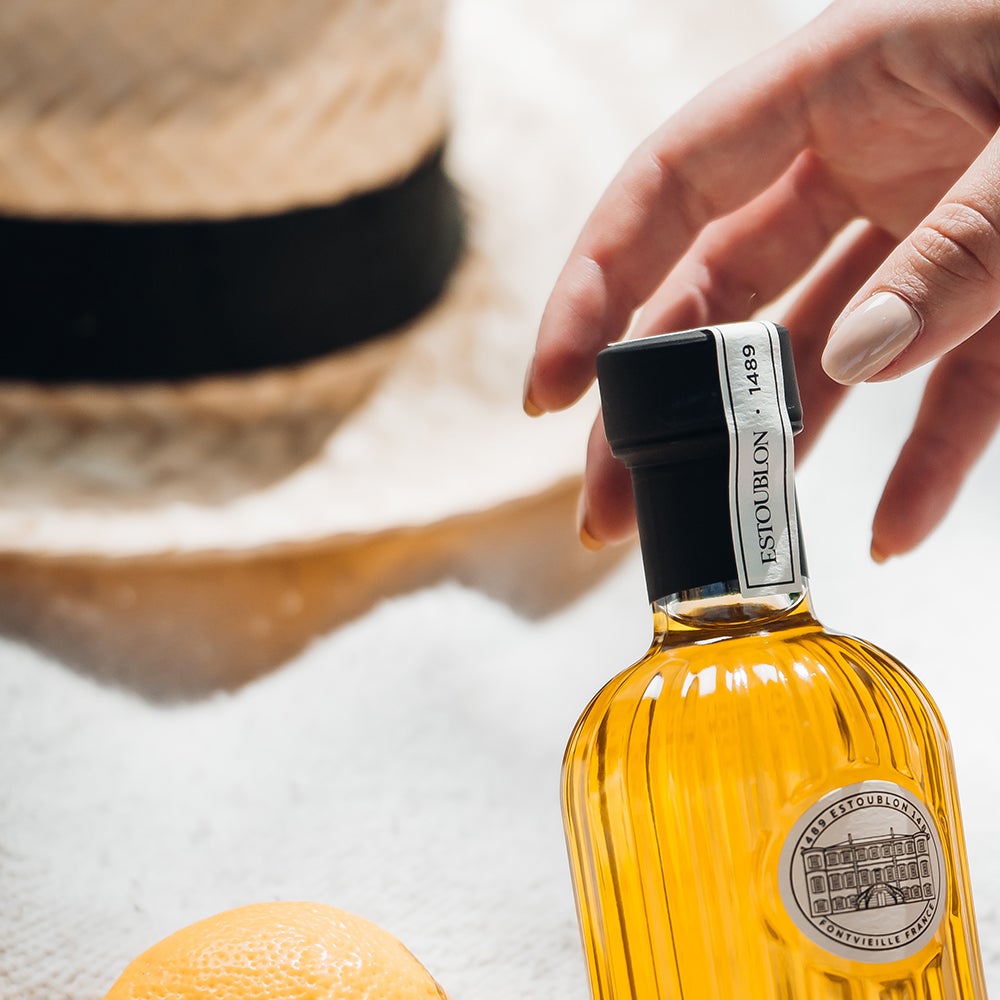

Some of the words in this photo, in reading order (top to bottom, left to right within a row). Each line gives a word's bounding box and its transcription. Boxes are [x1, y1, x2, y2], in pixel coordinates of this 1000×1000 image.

[743, 345, 762, 395] 1489
[753, 431, 777, 564] ESTOUBLON
[800, 818, 827, 850] 489
[830, 795, 909, 818] ESTOUBLON
[819, 919, 901, 946] FONTVIEILLE
[905, 903, 935, 939] FRANCE
